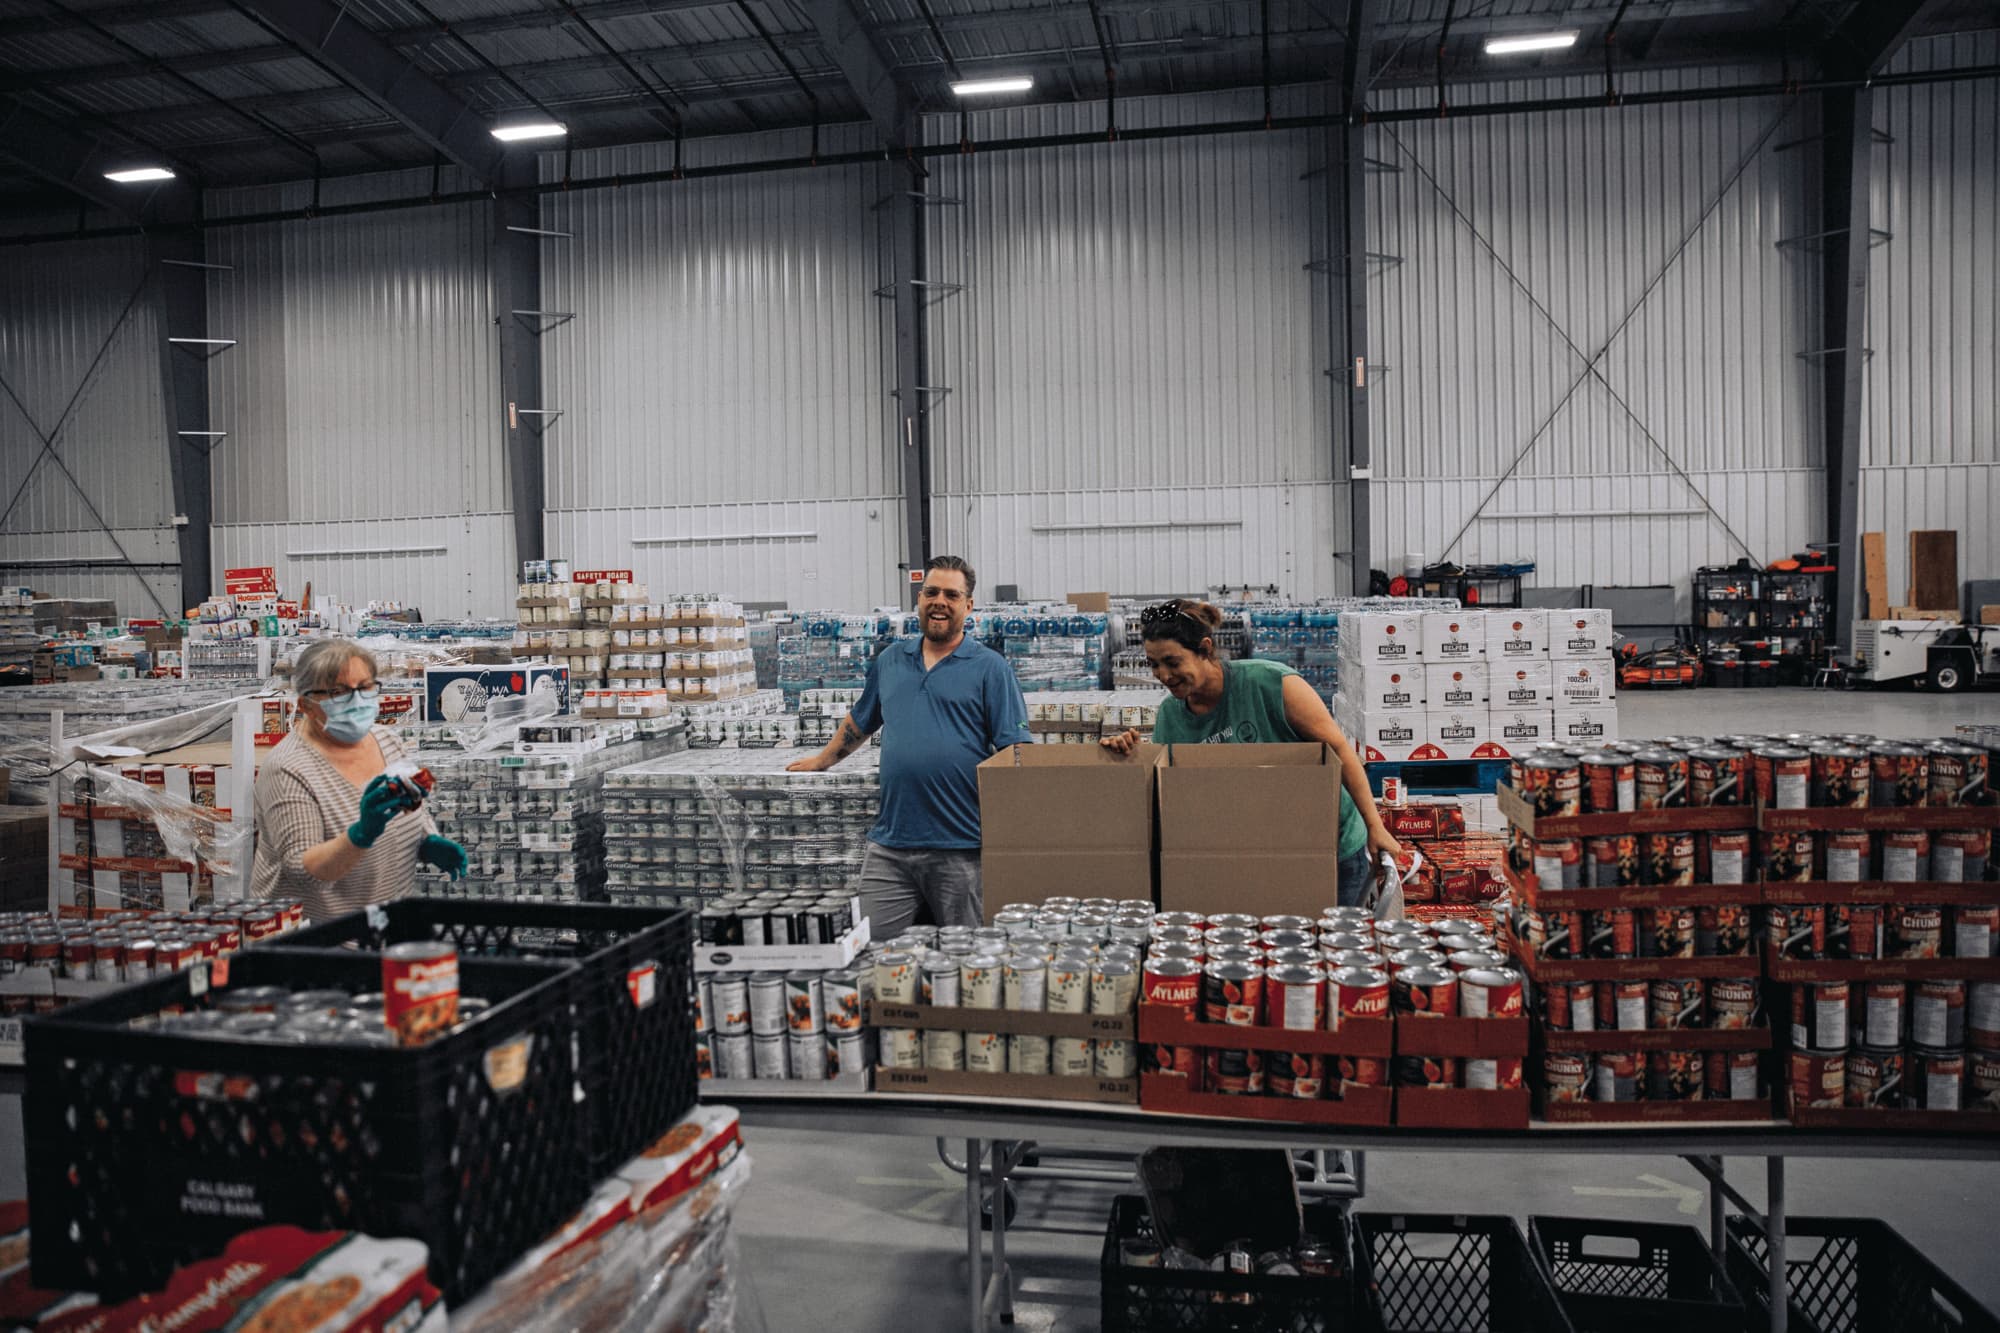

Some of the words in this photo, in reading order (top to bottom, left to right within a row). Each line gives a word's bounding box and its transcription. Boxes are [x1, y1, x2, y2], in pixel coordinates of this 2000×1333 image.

[576, 572, 602, 580] SAFETY
[606, 571, 629, 579] BOARD
[1444, 728, 1473, 737] HELPER
[1506, 727, 1537, 736] HELPER
[1571, 725, 1602, 734] HELPER
[1382, 731, 1411, 739] HELPER
[1397, 820, 1432, 830] AYLMER
[1150, 985, 1198, 1001] AYLMER
[1711, 986, 1753, 1001] CHUNKY
[1543, 1059, 1584, 1074] CHUNKY
[186, 1179, 255, 1200] CALGARY
[181, 1195, 220, 1215] FOOD
[224, 1199, 264, 1218] BANK
